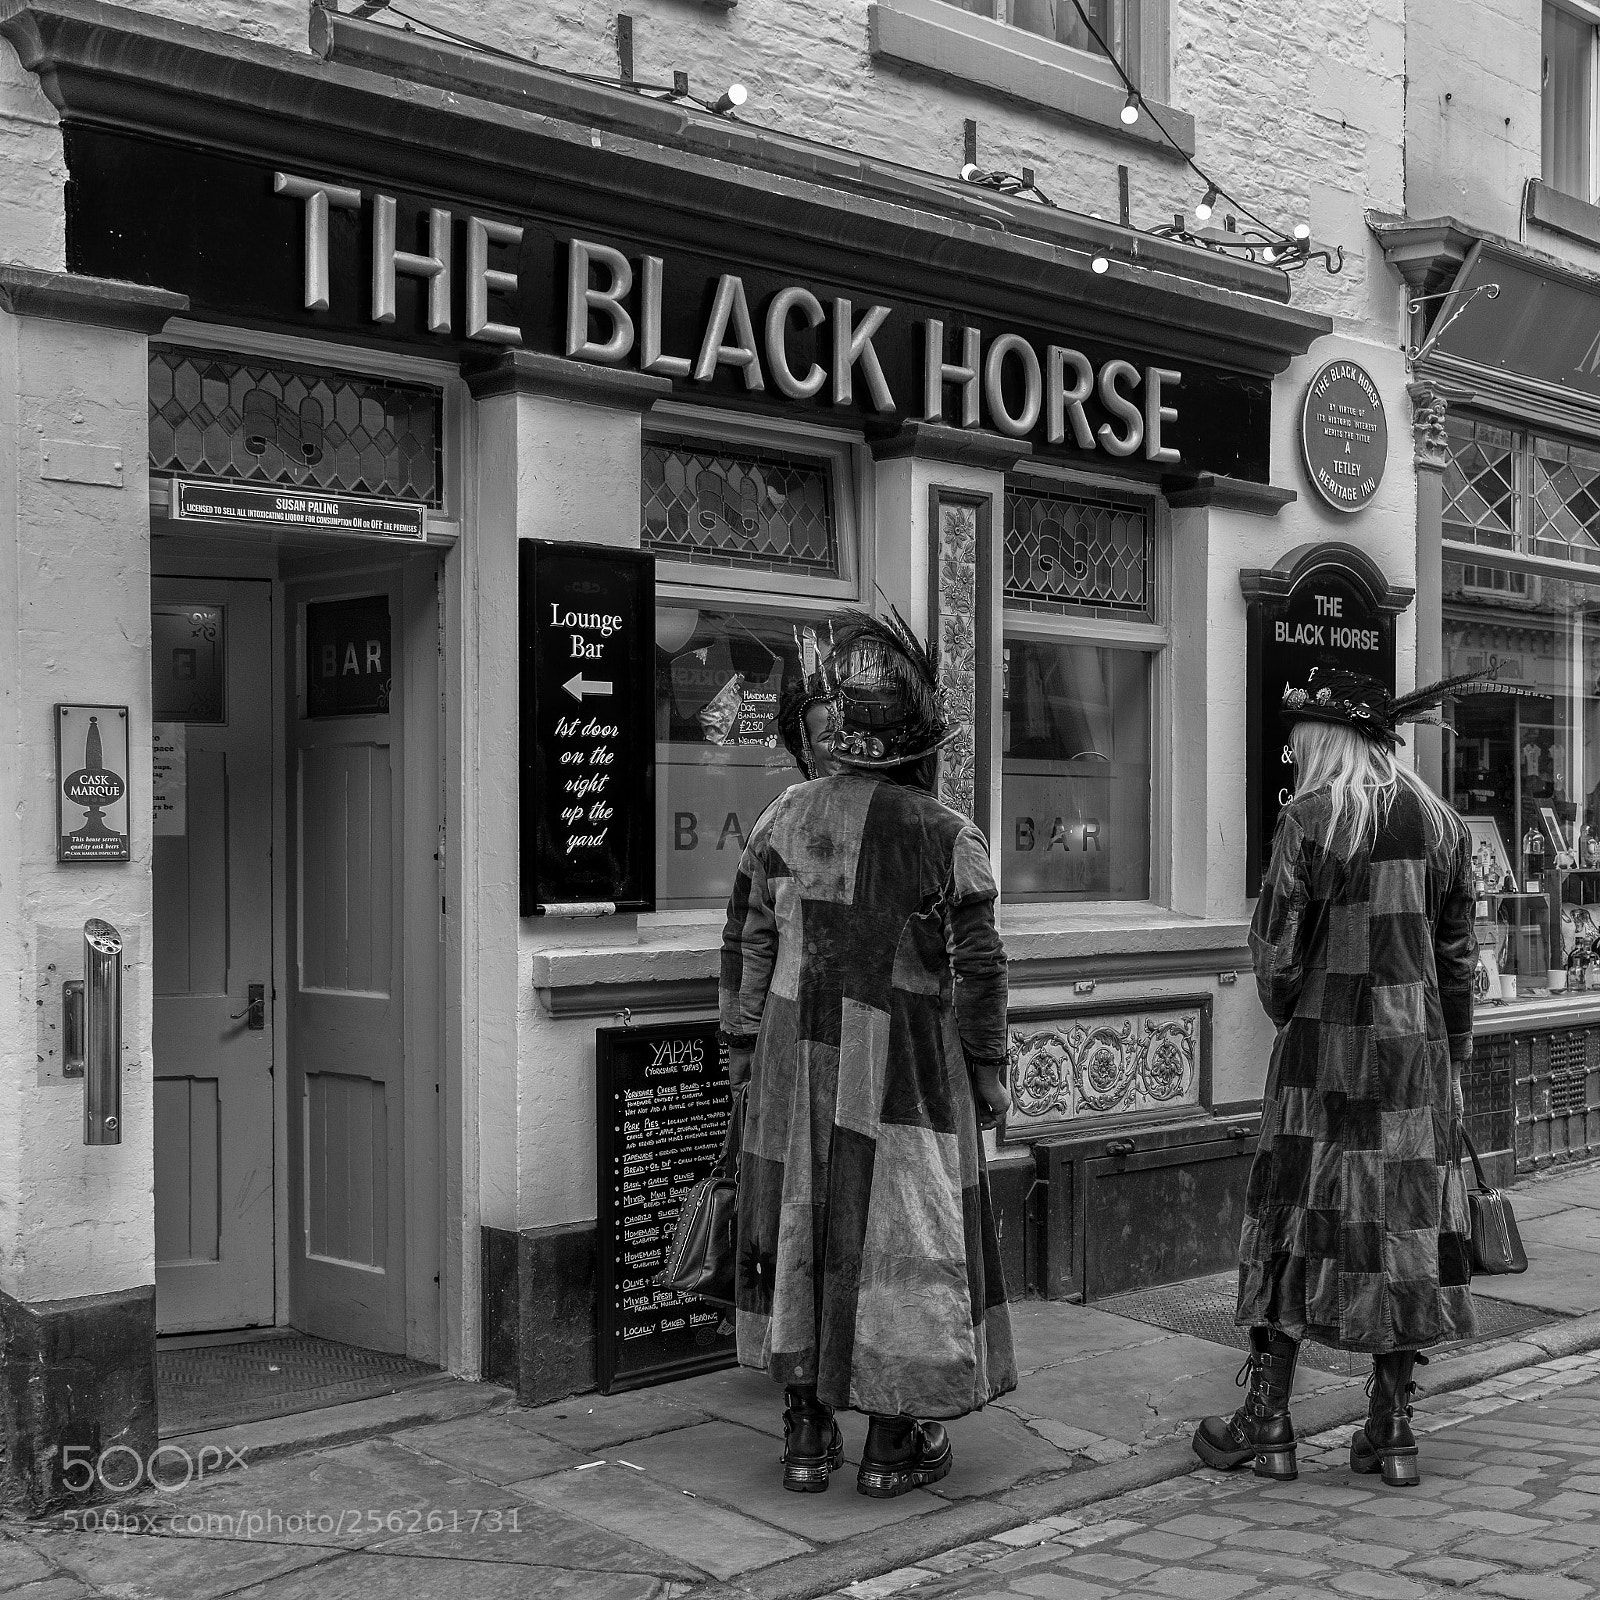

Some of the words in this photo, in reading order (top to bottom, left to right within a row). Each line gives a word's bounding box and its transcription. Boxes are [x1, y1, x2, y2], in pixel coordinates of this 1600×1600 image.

[274, 171, 524, 342] THE
[566, 237, 896, 413] BLACK
[925, 318, 1182, 462] HORSE
[1313, 374, 1330, 398] THE
[1330, 365, 1356, 382] BLACK
[1358, 373, 1380, 410] HORSE
[1329, 403, 1336, 411] BY
[1338, 404, 1356, 416] VIRTUE
[1359, 409, 1365, 417] OF
[1316, 412, 1326, 422] ITS
[1328, 415, 1351, 427] HISTORIC
[1354, 419, 1378, 432] INTEREST
[1324, 427, 1343, 438] MERITS
[1344, 431, 1354, 440] THE
[1356, 433, 1371, 444] TITLE
[1345, 441, 1351, 454] A
[1333, 460, 1361, 477] TETLEY
[1318, 467, 1357, 501] HERITAGE
[1360, 476, 1376, 497] INN
[276, 498, 305, 512] SUSAN
[307, 501, 339, 515] PALING
[187, 503, 214, 514] LICENSED
[214, 506, 222, 514] TO
[223, 507, 236, 516] SELL
[237, 508, 247, 517] ALL
[248, 509, 284, 520] INTOXICATING
[285, 513, 304, 522] LIQUOR
[305, 514, 316, 523] FOR
[316, 516, 352, 526] CONSUMPTION
[352, 517, 362, 527] ON
[363, 520, 370, 528] OR
[371, 519, 383, 529] OFF
[383, 522, 392, 530] THE
[393, 523, 418, 533] PREMISES
[1314, 595, 1343, 618] THE
[550, 602, 623, 637] Lounge
[1275, 621, 1324, 646] BLACK
[1330, 626, 1379, 651] HORSE
[569, 634, 604, 658] Bar
[322, 640, 382, 677] BAR
[744, 690, 777, 701] HANDMADE
[738, 711, 774, 720] BANDANAS
[740, 703, 756, 712] DOG
[554, 716, 582, 737] 1st
[581, 716, 619, 738] door
[739, 721, 764, 732] £2.50
[738, 738, 764, 746] WELCOME
[560, 750, 584, 765] on
[589, 744, 614, 765] the
[1281, 744, 1293, 763] &
[79, 775, 109, 785] CASK
[563, 772, 609, 799] right
[70, 785, 119, 798] MARQUE
[560, 804, 583, 827] up
[589, 800, 613, 821] the
[674, 812, 746, 851] BA
[1015, 816, 1101, 851] BAR
[565, 827, 608, 855] yard
[650, 1038, 704, 1067] YAPAS
[681, 1061, 703, 1073] TAPAS)
[624, 1088, 654, 1099] YORKSHIRE
[657, 1085, 677, 1095] CHEESE
[680, 1082, 700, 1090] BOARD
[669, 1102, 686, 1110] BOTTLE
[624, 1121, 640, 1132] PORK
[644, 1118, 659, 1129] PIES
[667, 1117, 688, 1126] LOCALLY
[622, 1151, 654, 1162] TAPENADE
[623, 1165, 644, 1175] BREAD
[649, 1162, 660, 1170] OIL
[661, 1159, 672, 1168] DIP
[623, 1181, 642, 1191] BASIL
[647, 1176, 669, 1186] GARLIC
[673, 1172, 695, 1181] OLIVES
[623, 1194, 646, 1206] MIXED
[650, 1190, 666, 1200] MINI
[669, 1186, 691, 1196] BOARD
[643, 1201, 661, 1209] BREAD
[624, 1213, 652, 1224] CHORIZO
[657, 1208, 679, 1218] SLICES
[624, 1226, 660, 1239] HOMEMADE
[624, 1248, 661, 1263] HOMEMADE
[632, 1260, 660, 1269] CIABATTA
[622, 1278, 644, 1290] OLIVE
[623, 1296, 649, 1308] MIXED
[652, 1290, 673, 1302] FRESH
[623, 1323, 656, 1338] LOCALLY
[661, 1318, 686, 1330] BAKED
[690, 1312, 718, 1325] HERRING
